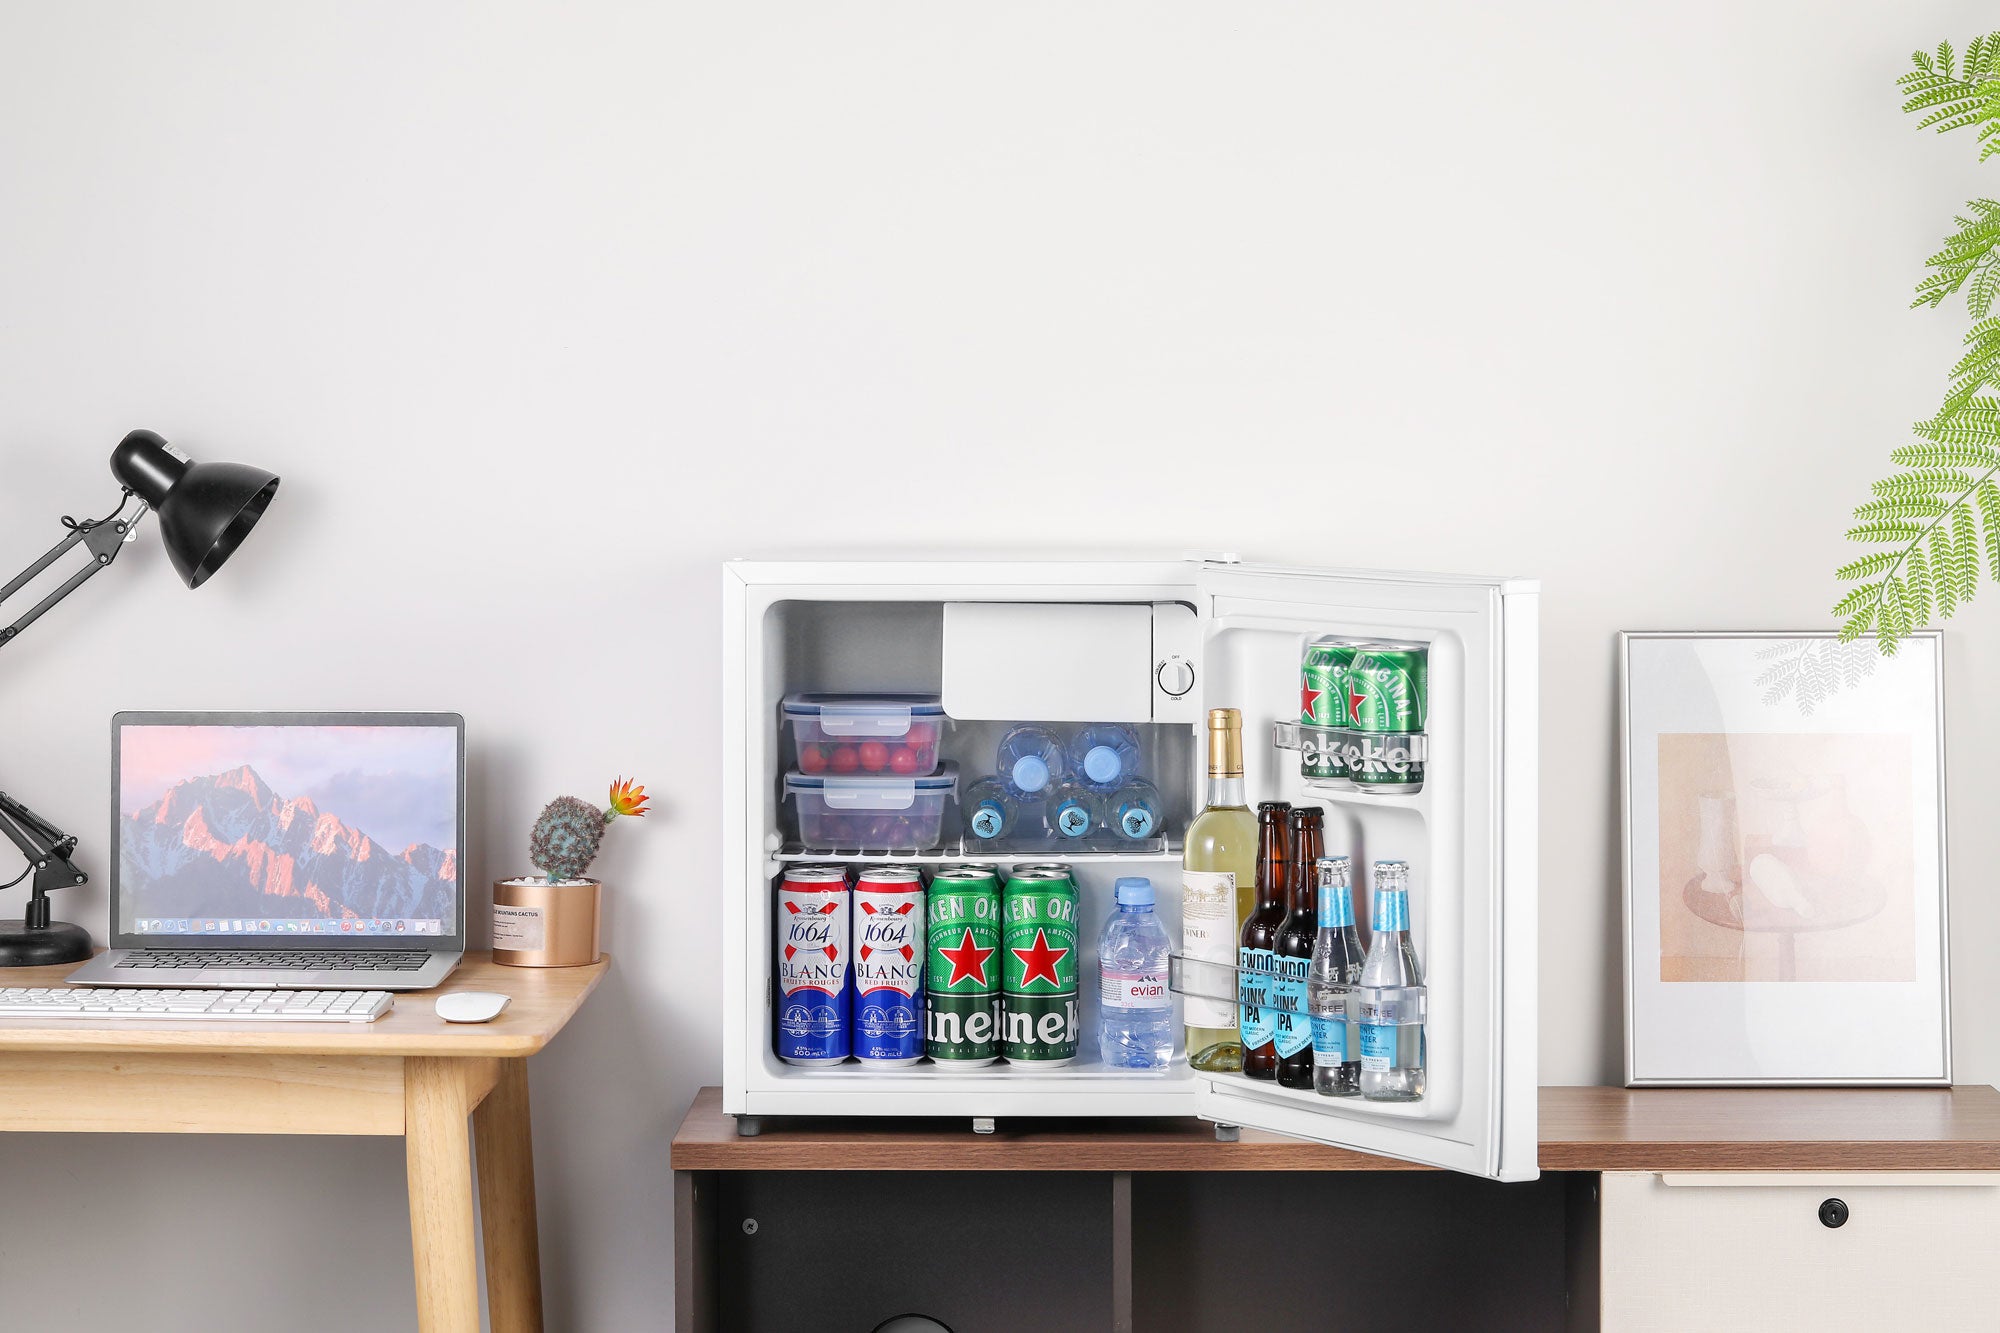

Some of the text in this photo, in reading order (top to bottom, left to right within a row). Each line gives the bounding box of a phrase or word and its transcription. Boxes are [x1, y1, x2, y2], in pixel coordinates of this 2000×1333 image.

[1356, 655, 1412, 722] ORIGINAL
[789, 921, 833, 943] 1664
[864, 921, 909, 944] 1664
[782, 963, 842, 979] BLANC
[857, 962, 918, 979] BLANC
[808, 978, 840, 986] ROUGES
[1130, 984, 1164, 996] evian
[1240, 986, 1267, 1006] PUNK
[1273, 993, 1299, 1011] PUNK
[1244, 1005, 1260, 1024] IPA
[1277, 1012, 1293, 1032] IPA
